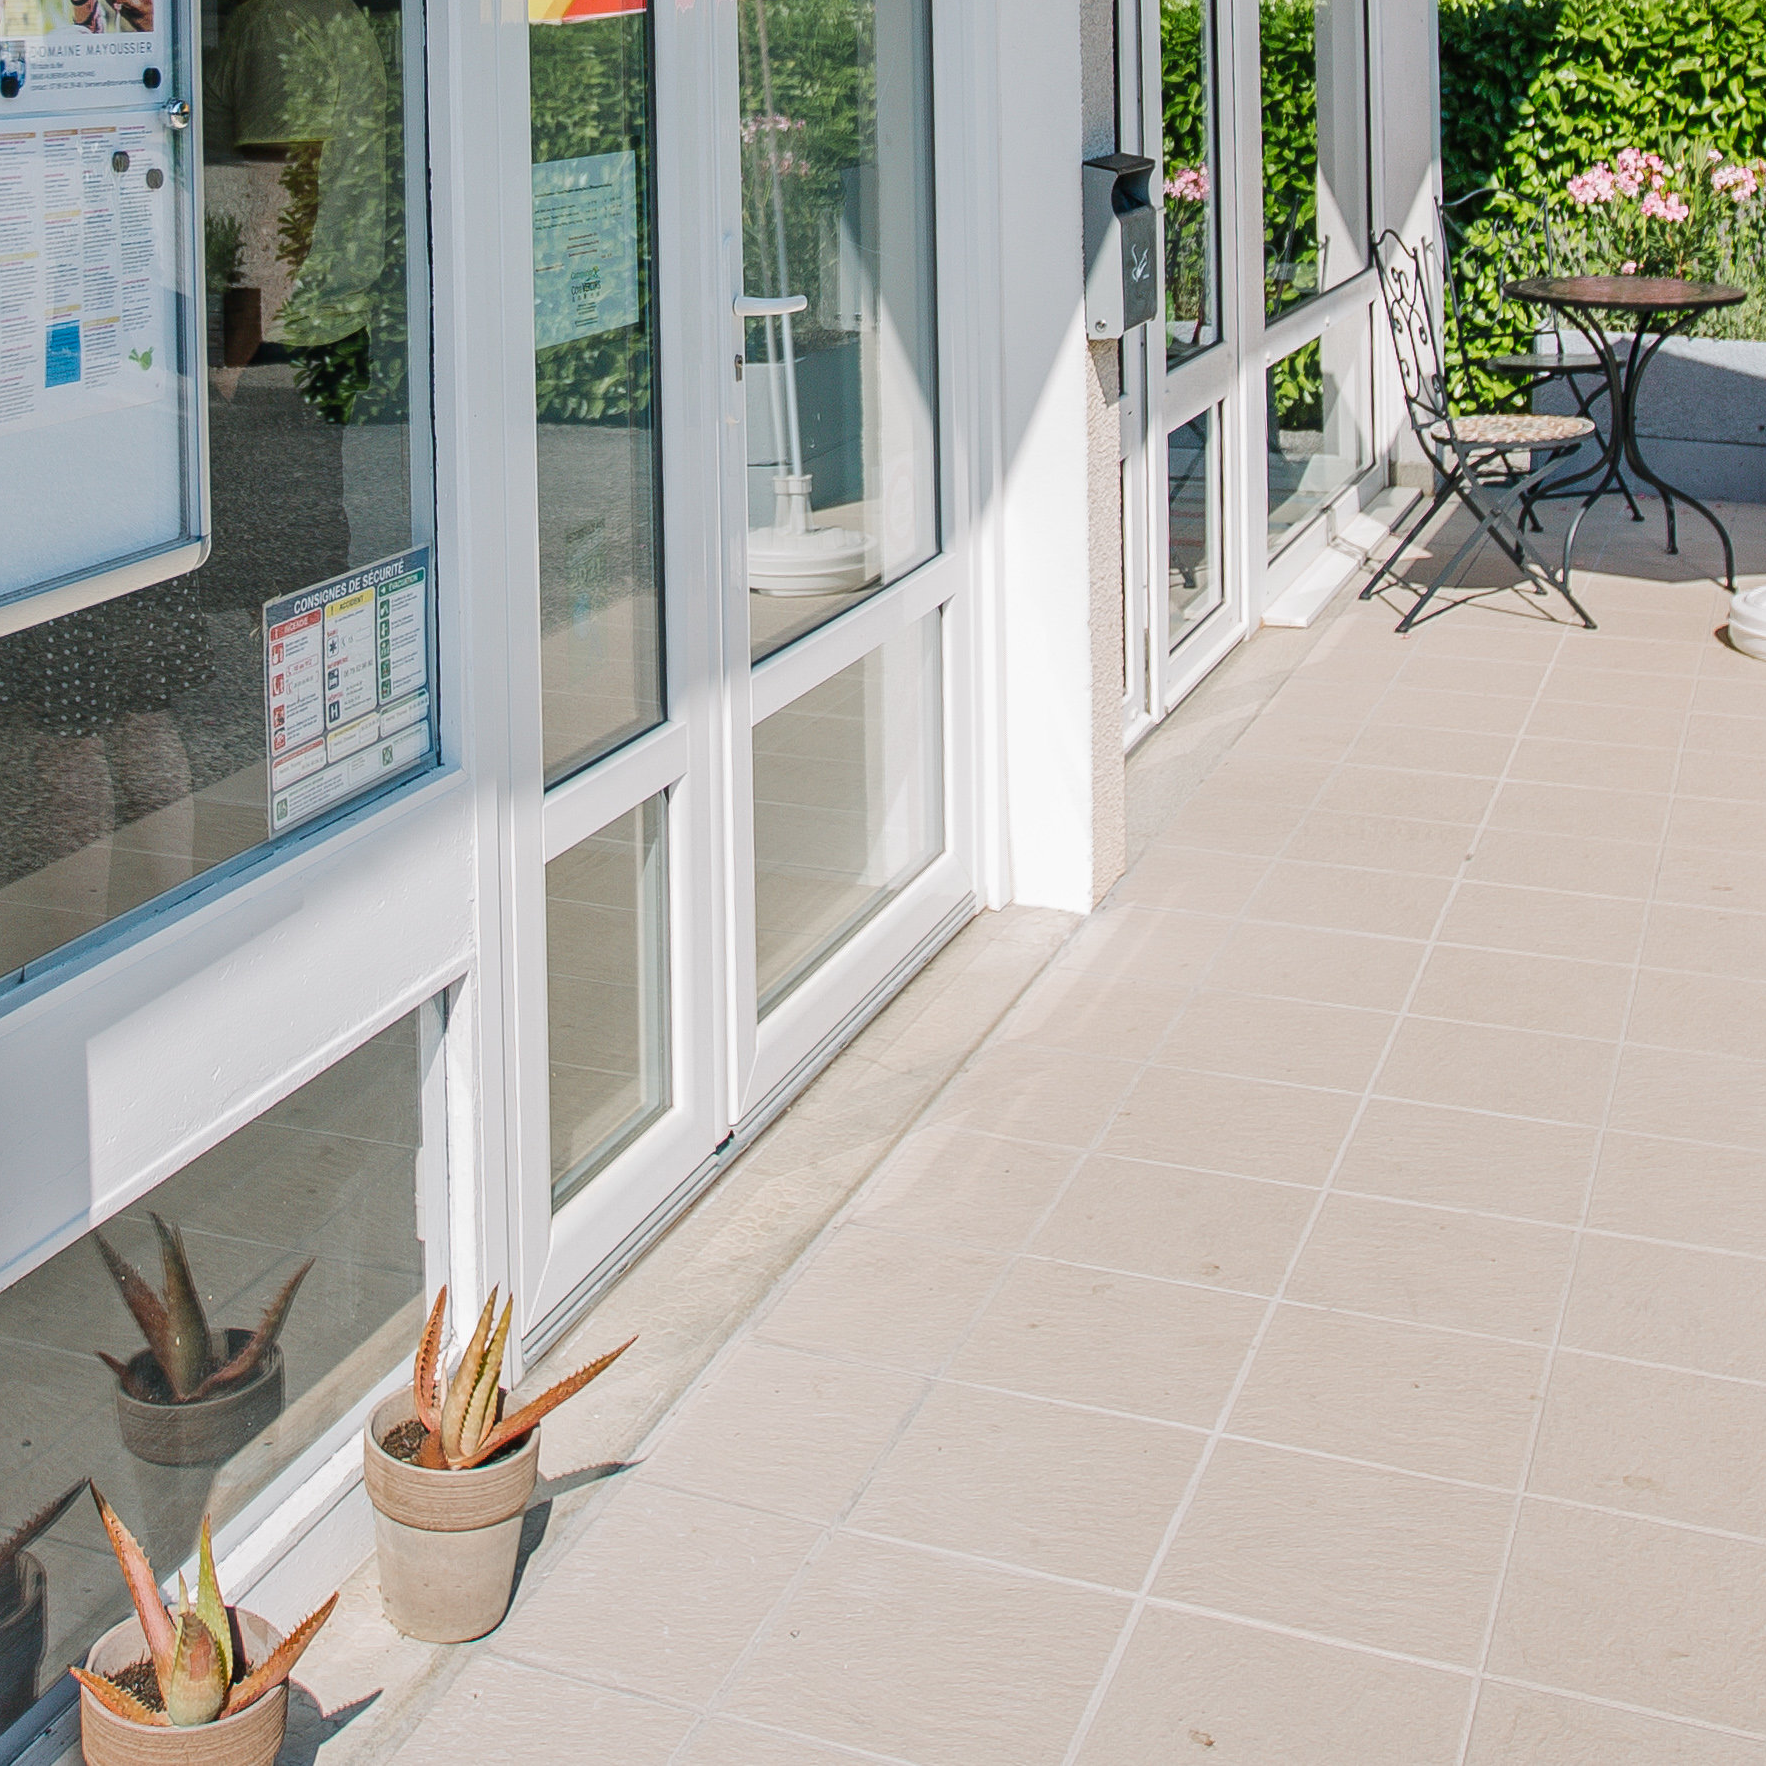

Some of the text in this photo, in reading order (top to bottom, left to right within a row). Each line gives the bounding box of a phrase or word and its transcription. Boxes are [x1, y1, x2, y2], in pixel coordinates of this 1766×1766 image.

[30, 42, 153, 58] DOMAINE MAYOUSSIER
[294, 560, 405, 614] CONSIGNES DE SÉCURITÉ
